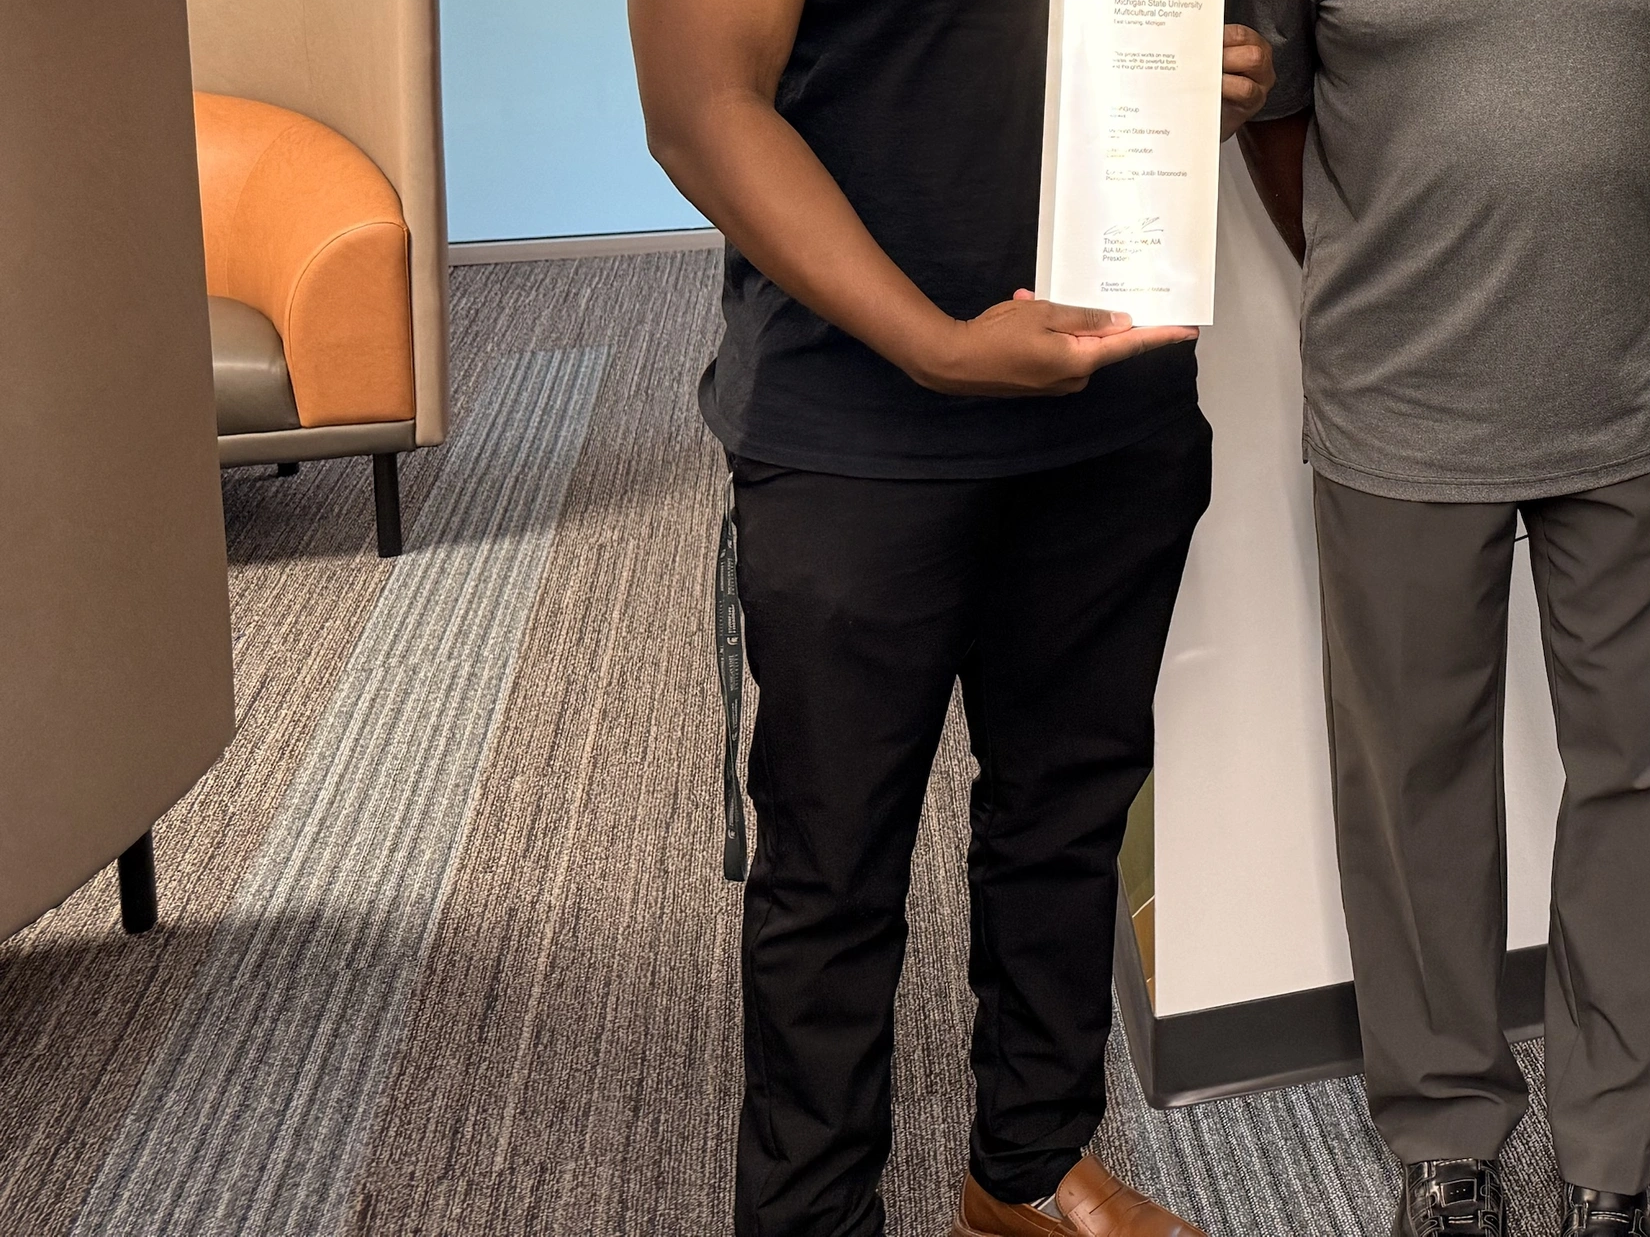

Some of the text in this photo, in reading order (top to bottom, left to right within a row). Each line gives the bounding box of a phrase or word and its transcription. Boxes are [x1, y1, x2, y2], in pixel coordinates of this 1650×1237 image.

[1168, 0, 1203, 10] University
[1113, 8, 1183, 18] Multicultural Center
